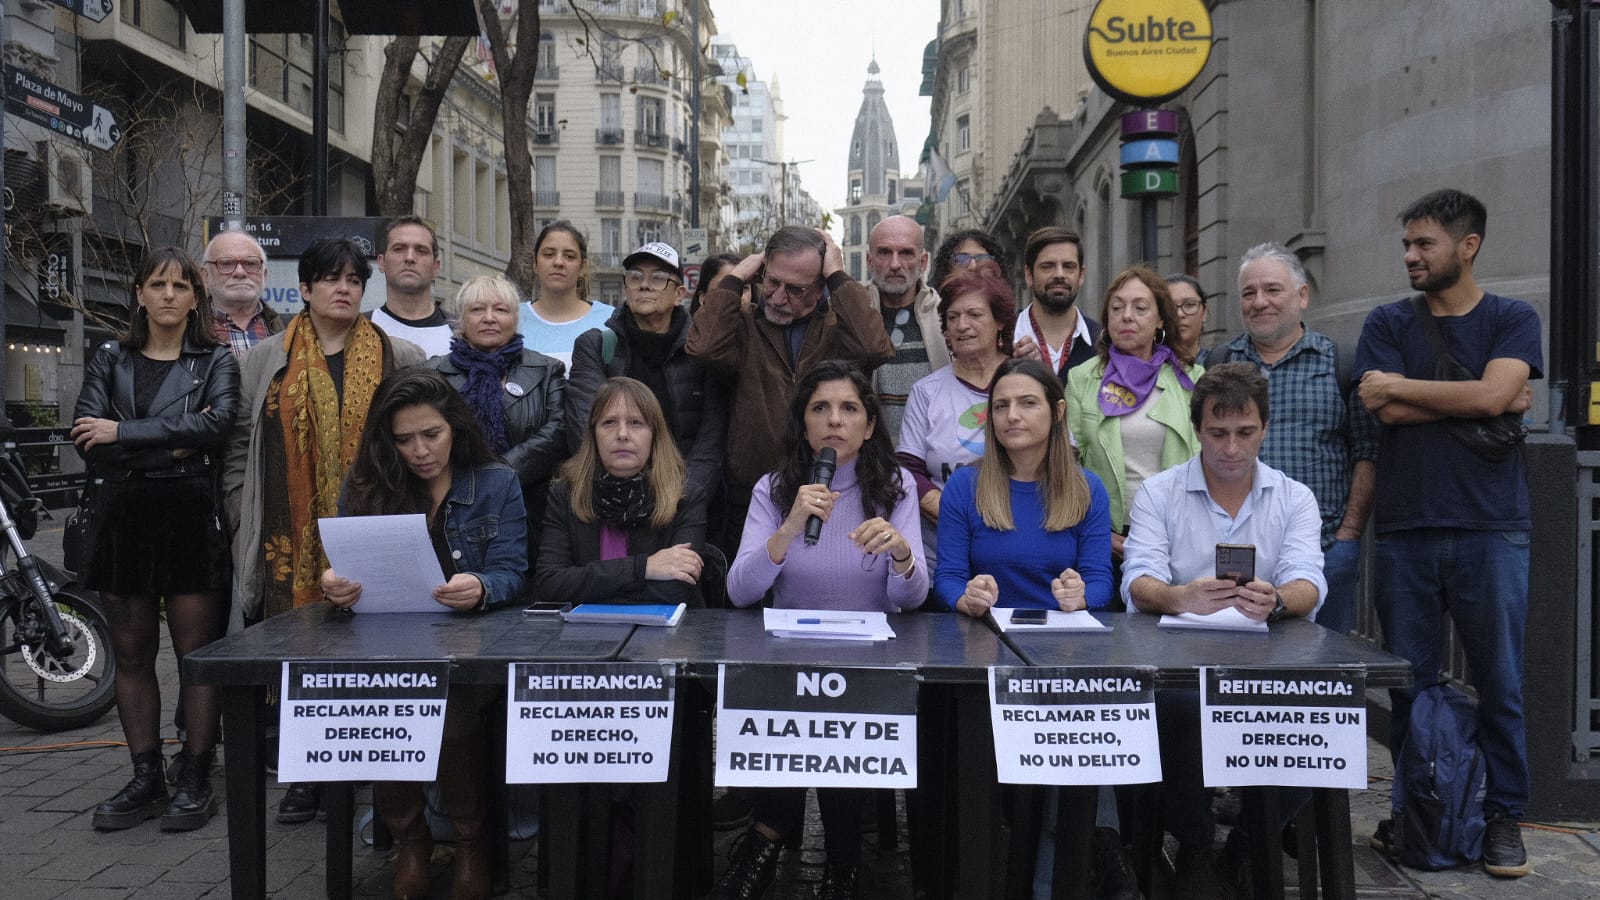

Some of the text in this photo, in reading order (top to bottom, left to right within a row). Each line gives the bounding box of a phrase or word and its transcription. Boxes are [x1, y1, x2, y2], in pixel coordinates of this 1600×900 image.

[1102, 15, 1200, 43] Subte
[1105, 46, 1197, 56] Buenos Aires Ciudad
[16, 72, 41, 94] Plaza
[44, 87, 55, 100] de
[57, 91, 83, 112] Mayo
[1146, 111, 1158, 130] E
[1144, 141, 1162, 161] A
[1145, 171, 1161, 190] D
[261, 223, 272, 231] 16
[302, 673, 437, 688] REITERANCIA:
[528, 675, 663, 690] REITERANCIA:
[796, 671, 847, 698] NO
[1008, 678, 1142, 694] REITERANCIA:
[1219, 680, 1352, 696] REITERANCIA:
[293, 705, 441, 717] RECLAMAR ES UN
[520, 706, 669, 719] RECLAMAR ES UN
[1002, 708, 1150, 722] RECLAMAR ES UN
[1212, 711, 1360, 725] RECLAMAR ES UN
[325, 727, 412, 742] DERECHO,
[551, 729, 639, 744] DERECHO,
[739, 717, 899, 741] A LA LEY DE
[1034, 732, 1122, 746] DERECHO,
[1242, 733, 1329, 749] DERECHO,
[306, 750, 426, 763] NO UN DELITO
[533, 752, 654, 765] NO UN DELITO
[730, 752, 908, 776] REITERANCIA
[1020, 754, 1141, 767] NO UN DELITO
[1226, 756, 1346, 770] NO UN DELITO
